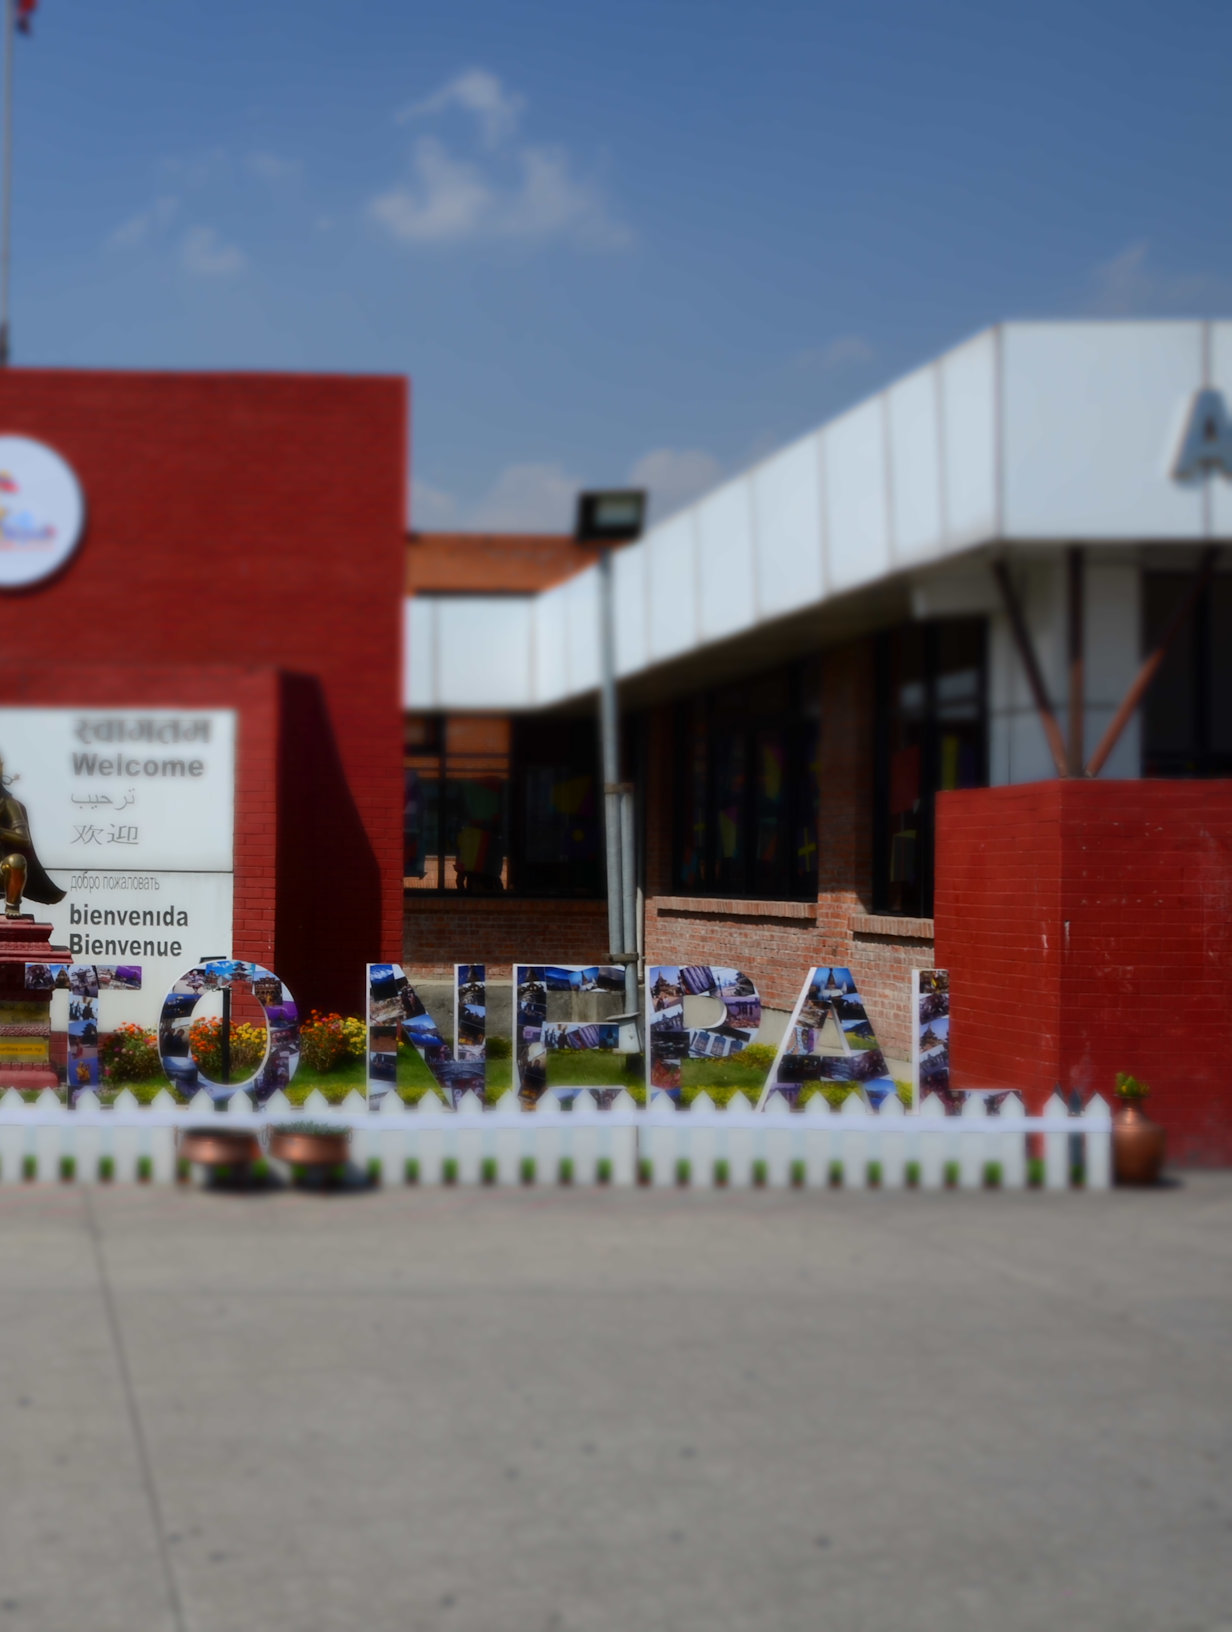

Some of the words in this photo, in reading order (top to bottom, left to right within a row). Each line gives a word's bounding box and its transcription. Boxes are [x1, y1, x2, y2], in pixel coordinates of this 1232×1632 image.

[72, 752, 205, 777] Welcome
[70, 824, 140, 846] 欢迎
[69, 871, 101, 894] добро
[102, 876, 161, 891] пожаловать
[69, 903, 189, 927] bienvenida
[69, 933, 183, 957] Bienvenue
[23, 959, 300, 1112] TO
[365, 962, 1026, 1114] NEPAL
